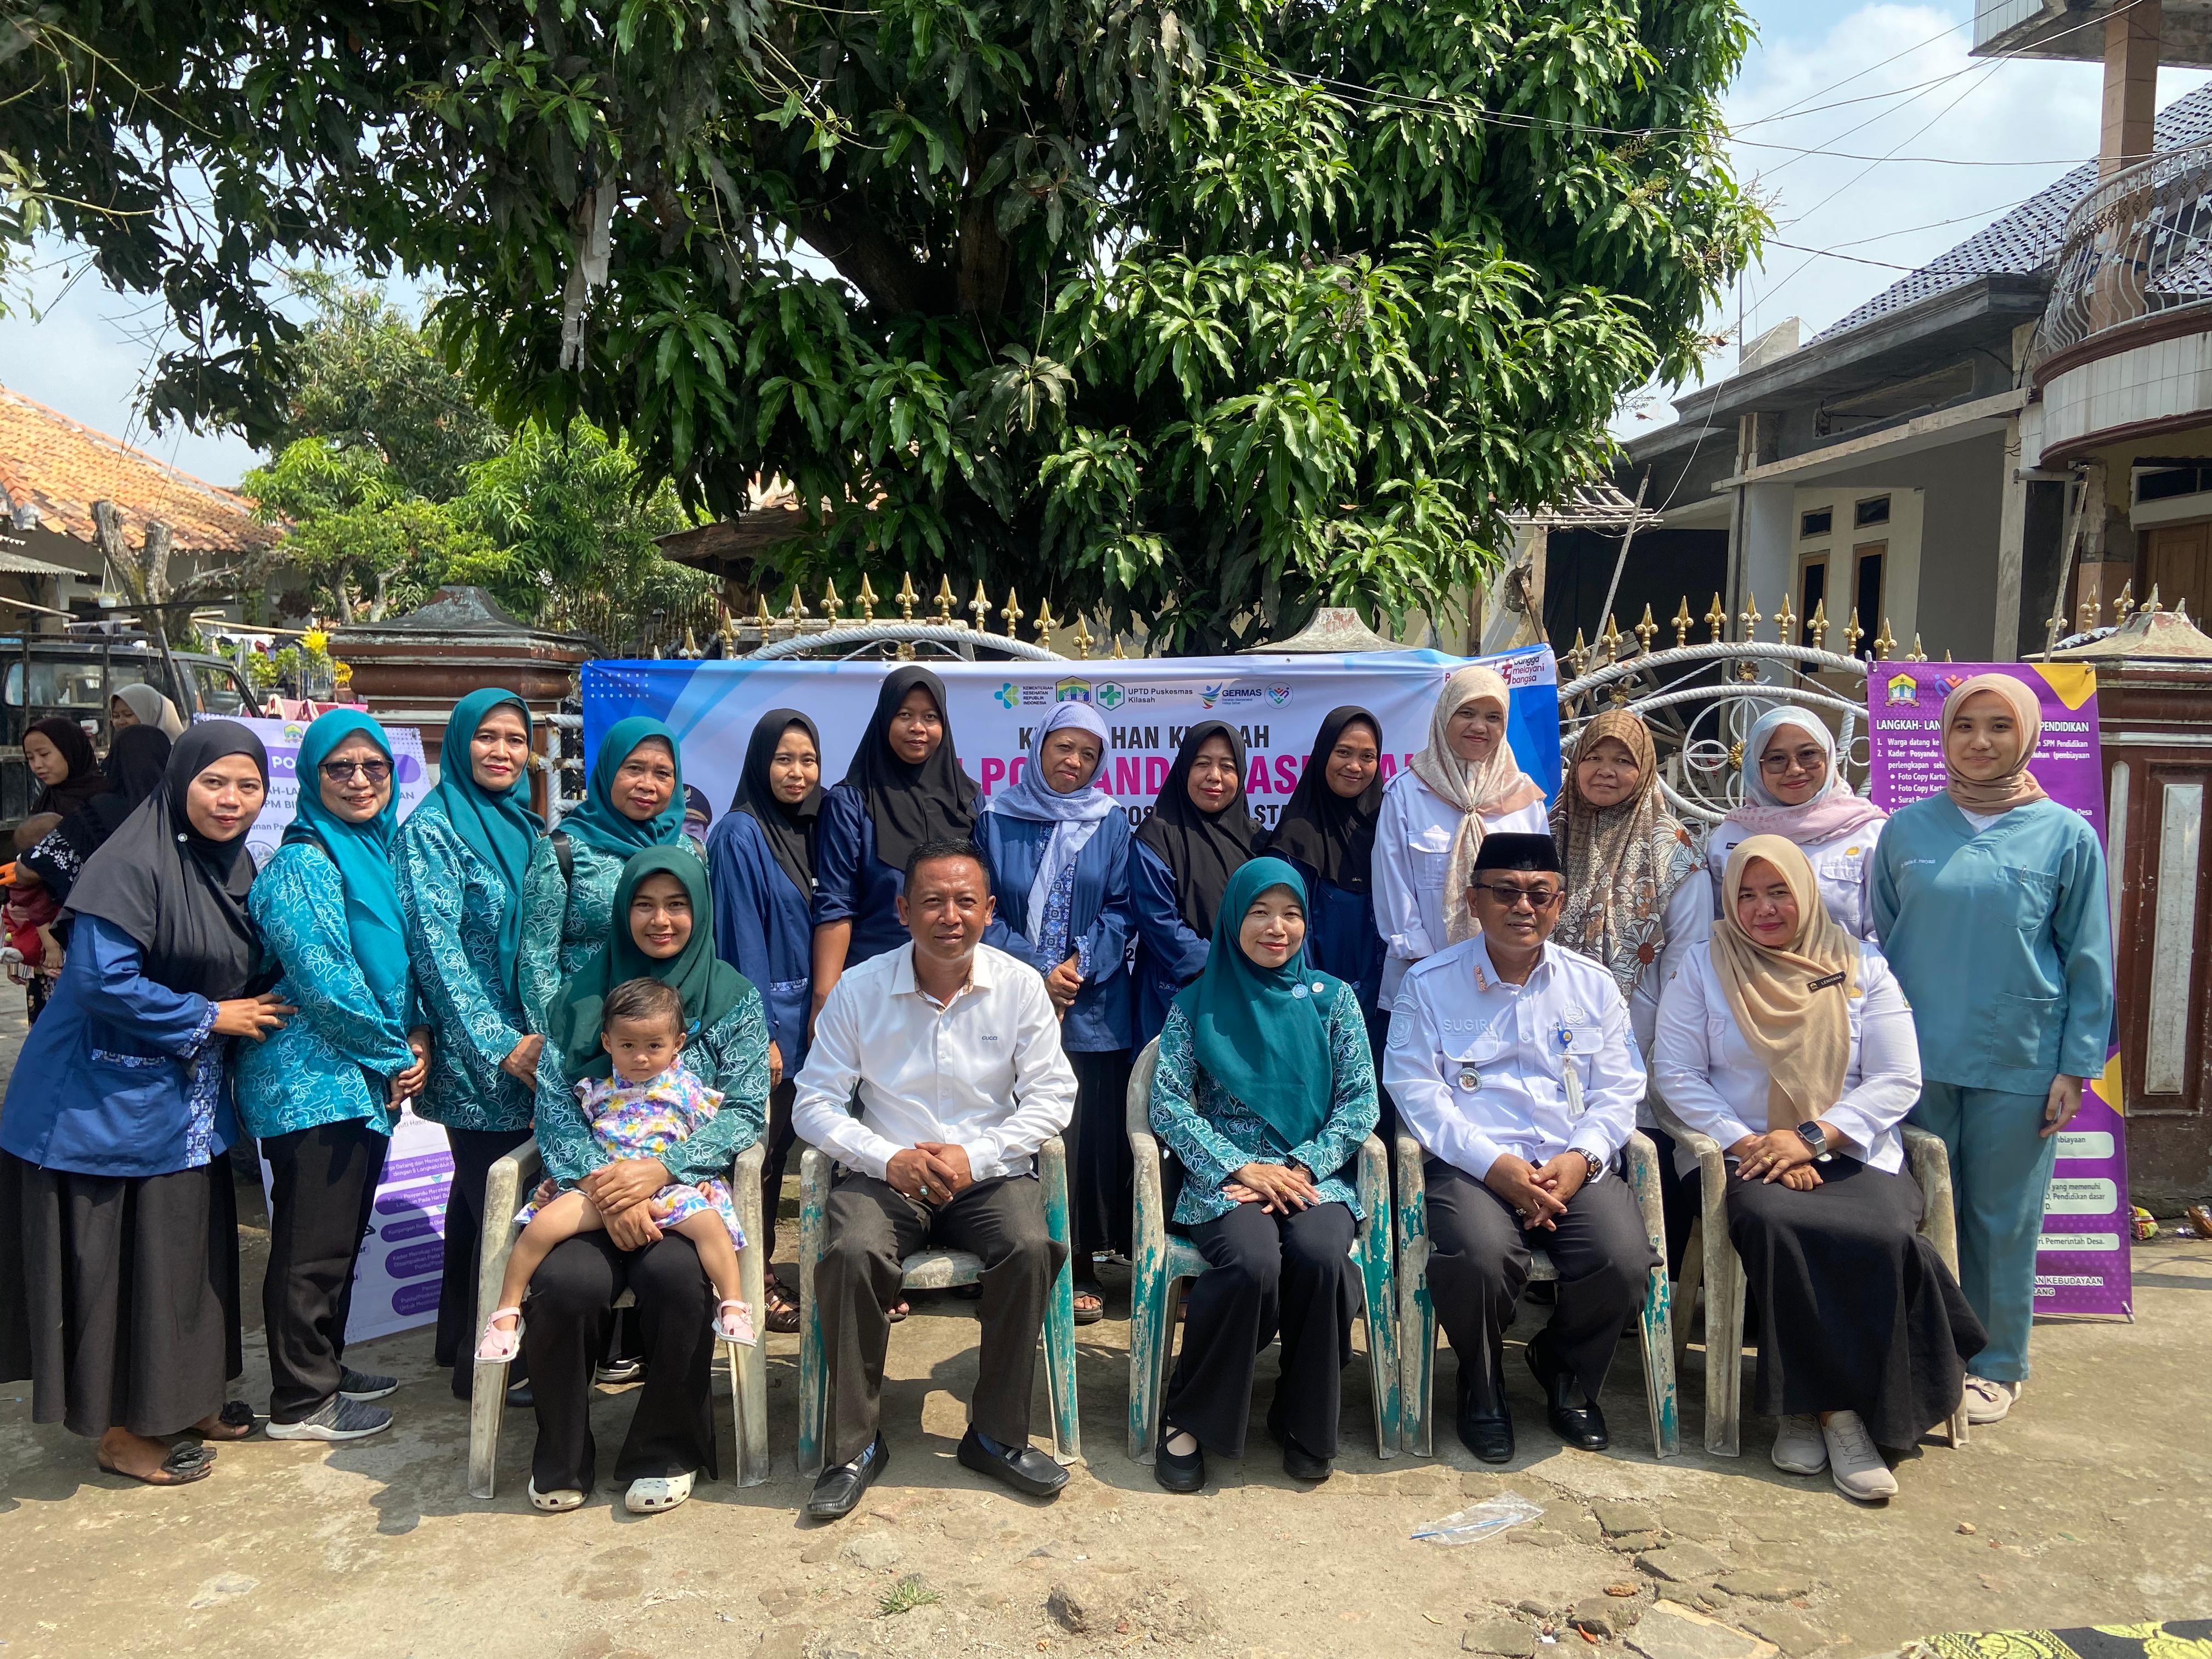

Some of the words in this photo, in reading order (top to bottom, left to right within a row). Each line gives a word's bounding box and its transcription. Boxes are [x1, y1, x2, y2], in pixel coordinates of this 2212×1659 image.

[1512, 663, 1544, 675] melayani
[1511, 675, 1537, 685] bangsa
[1222, 689, 1262, 697] GERMAS
[1876, 719, 1922, 730] LANGKAH-
[1925, 720, 1940, 730] LAN
[2040, 721, 2089, 732] PENDIDIKAN
[1887, 738, 1907, 747] Warga
[1909, 738, 1930, 747] datang
[1910, 749, 1938, 759] Posyandu
[272, 756, 295, 769] PO
[1888, 761, 1929, 770] perlengkapan
[1913, 773, 1928, 782] Copy
[1913, 785, 1928, 793] Copy
[2046, 1277, 2103, 1285] KEBUDAYAAN
